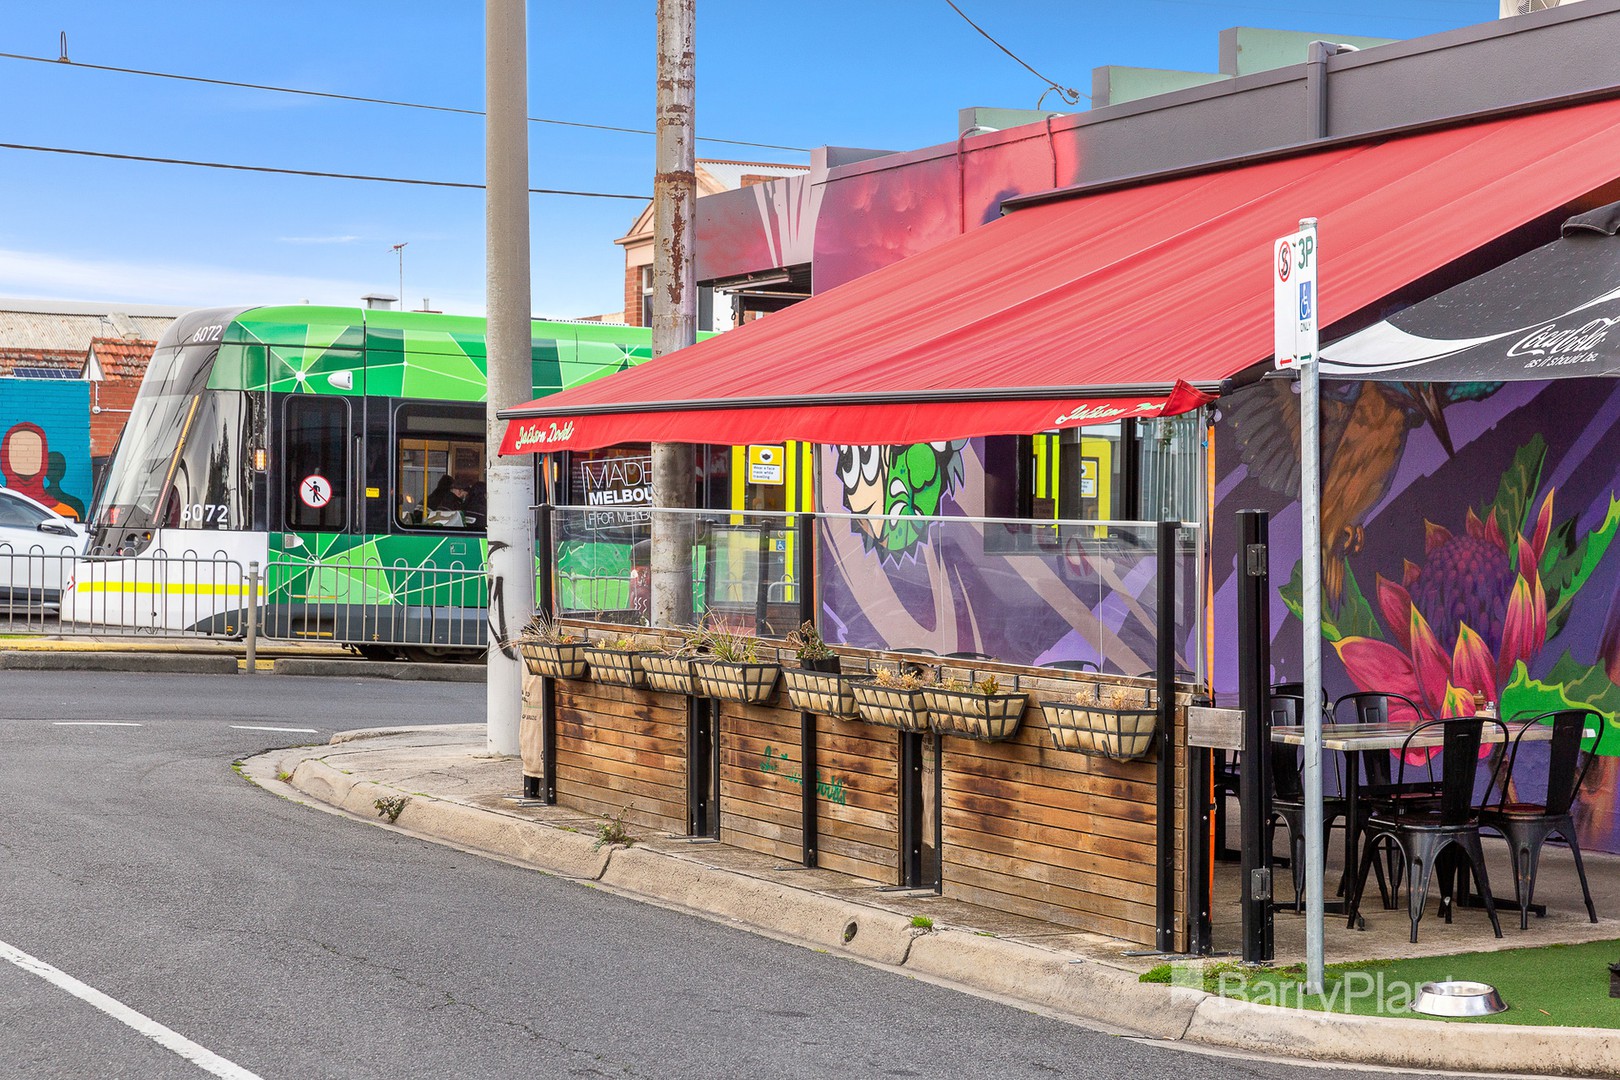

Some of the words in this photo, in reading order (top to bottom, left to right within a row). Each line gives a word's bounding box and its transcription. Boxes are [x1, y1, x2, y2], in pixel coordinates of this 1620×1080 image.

[1298, 235, 1314, 270] 3P
[192, 324, 223, 343] 6072
[1506, 318, 1612, 357] Coca-Cola
[586, 460, 652, 490] MADE
[181, 503, 229, 523] 6072
